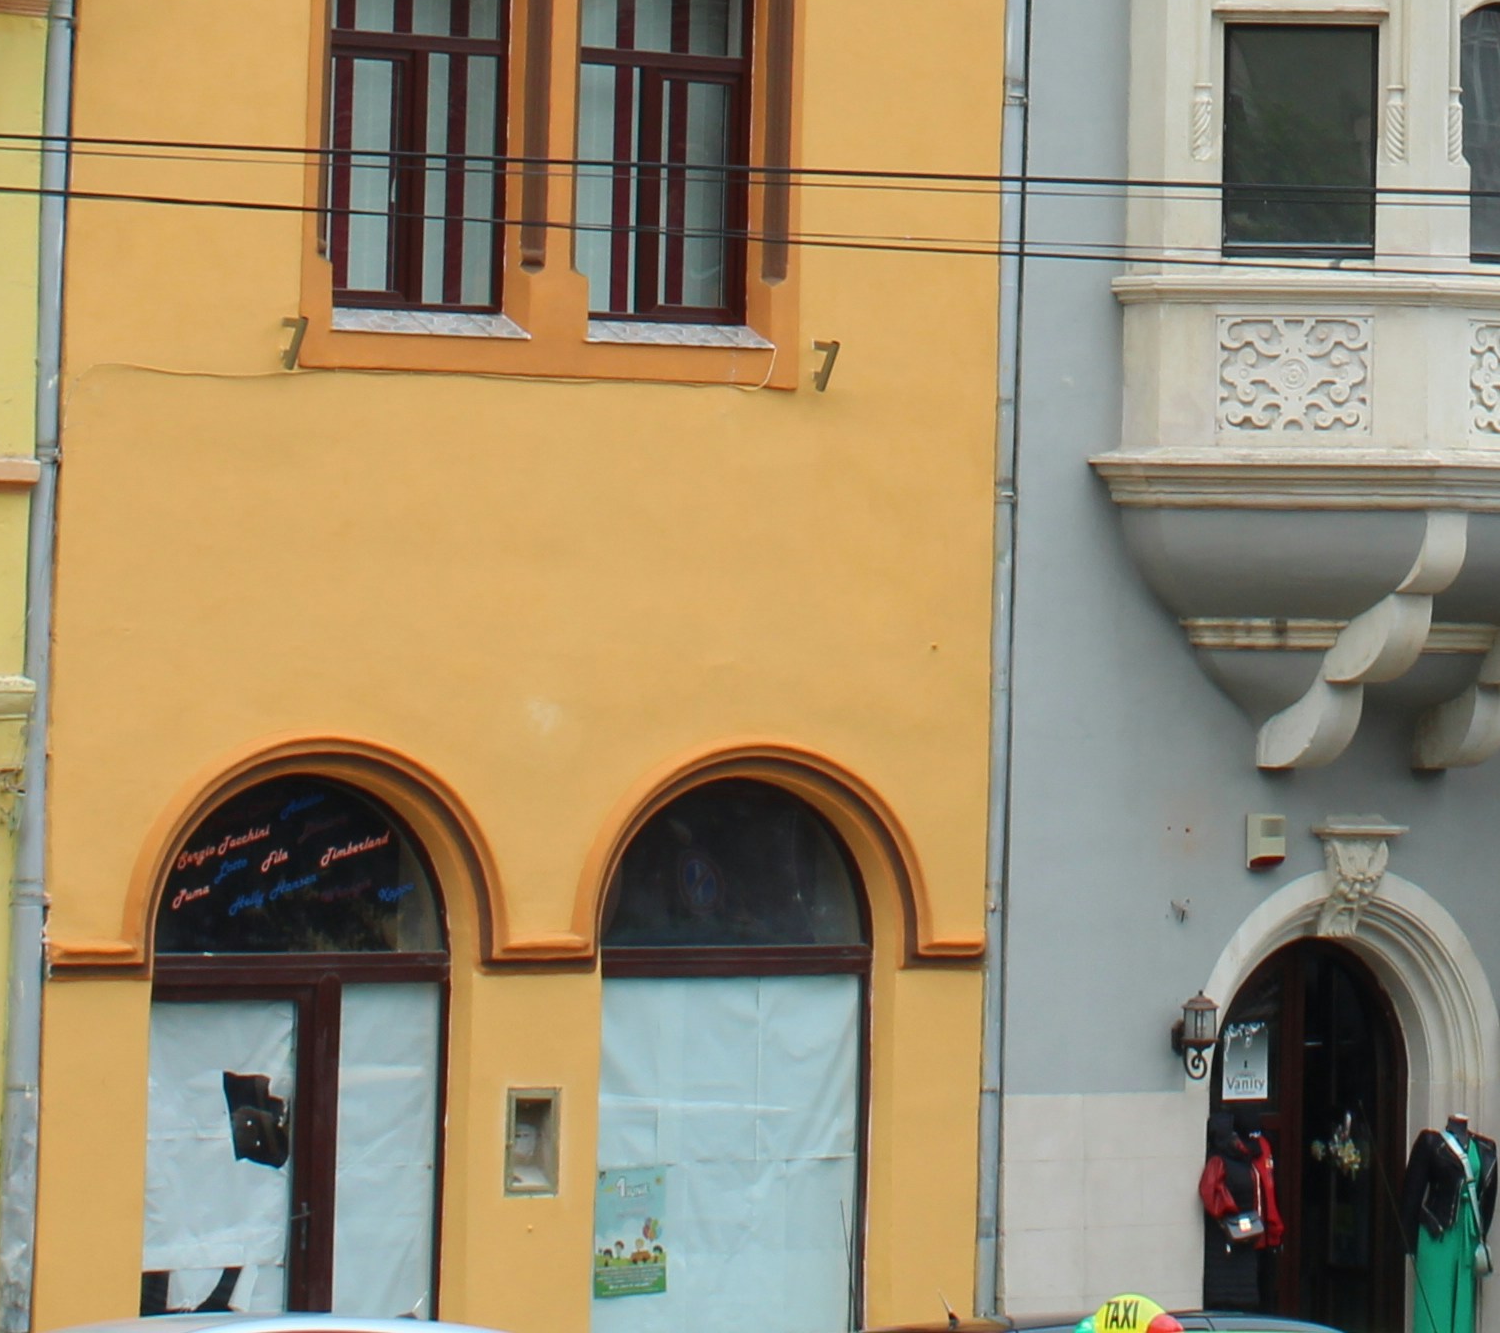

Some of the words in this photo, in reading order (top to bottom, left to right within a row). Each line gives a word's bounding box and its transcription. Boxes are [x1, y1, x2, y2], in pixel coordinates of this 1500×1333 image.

[178, 845, 216, 870] Sergio
[217, 824, 271, 855] Tacchini
[261, 848, 288, 872] Fila
[320, 830, 390, 867] Timberland
[172, 885, 210, 909] Puma
[228, 890, 265, 916] Helly
[268, 874, 317, 901] Hansen
[1226, 1076, 1265, 1091] Vanity
[1104, 1300, 1139, 1330] TAXI
